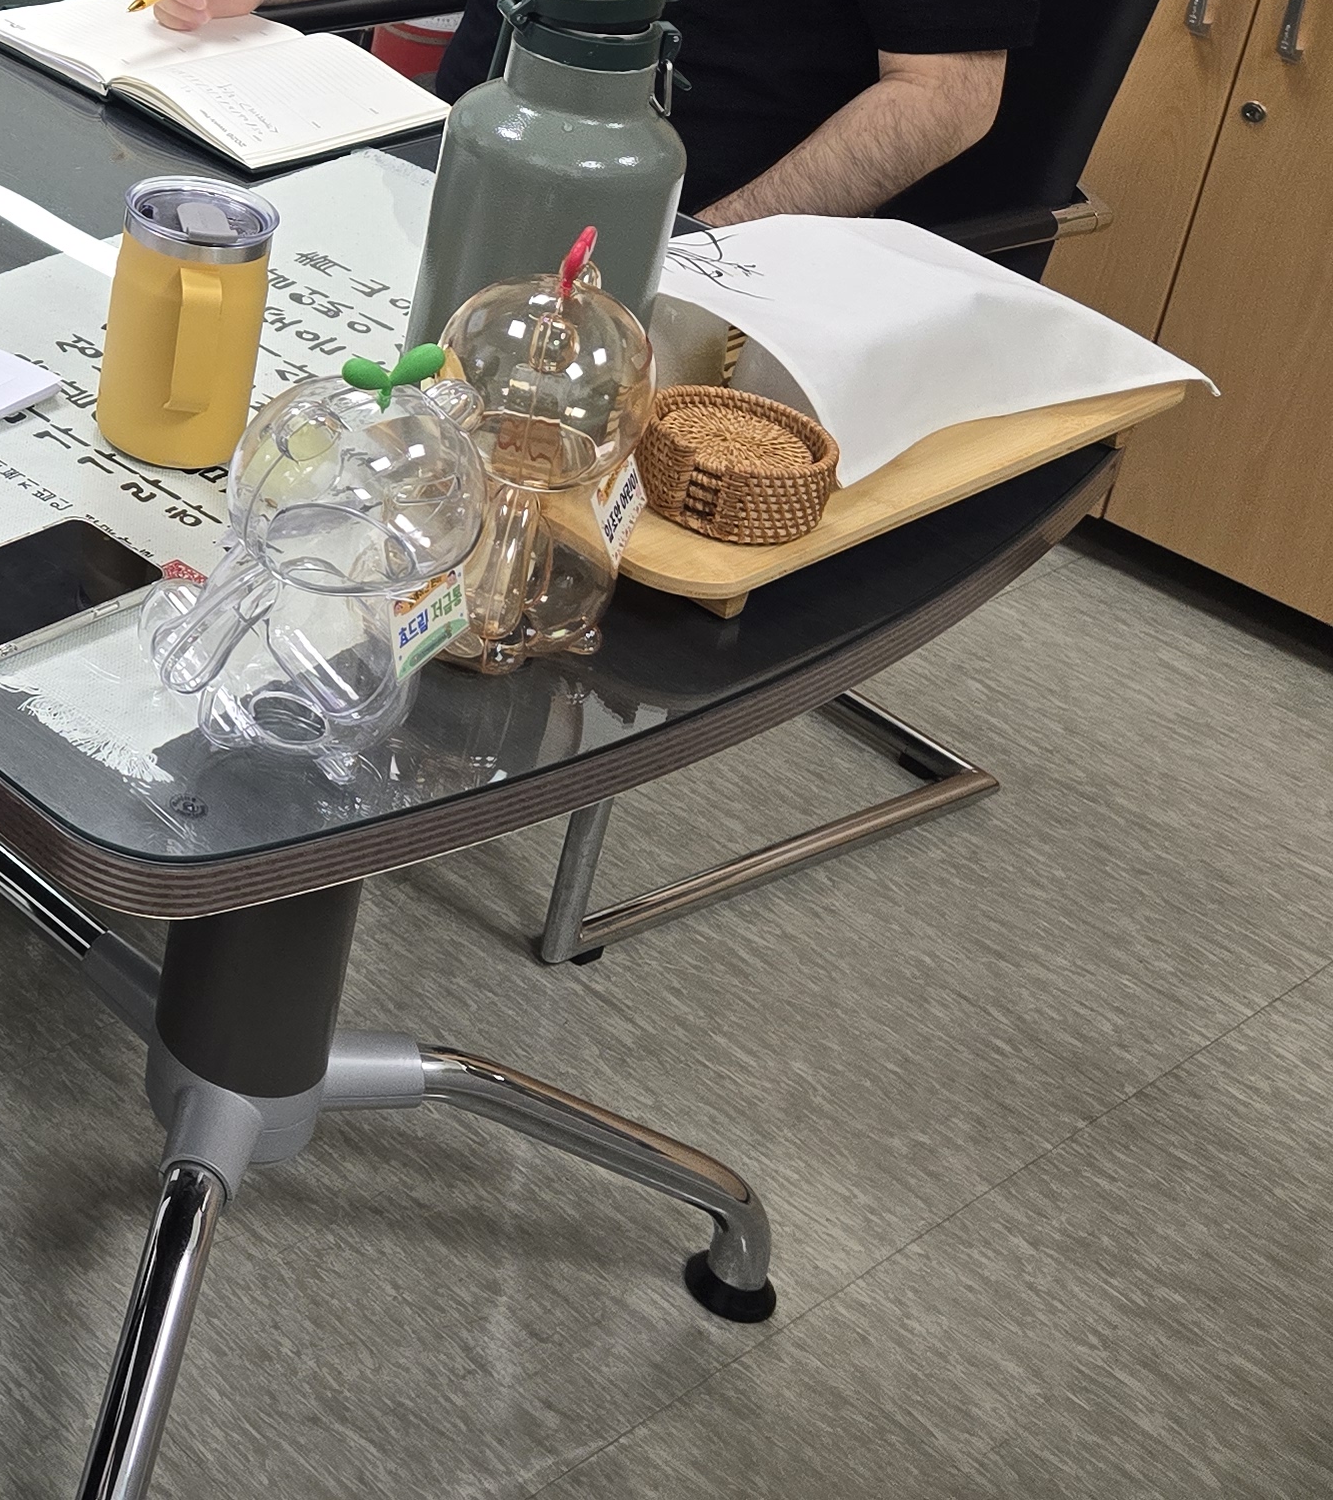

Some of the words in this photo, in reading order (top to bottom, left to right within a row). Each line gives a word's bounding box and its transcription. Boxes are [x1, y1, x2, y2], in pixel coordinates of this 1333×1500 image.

[619, 468, 639, 510] 어린이
[398, 608, 429, 649] 효드림
[430, 583, 463, 622] 저금통
